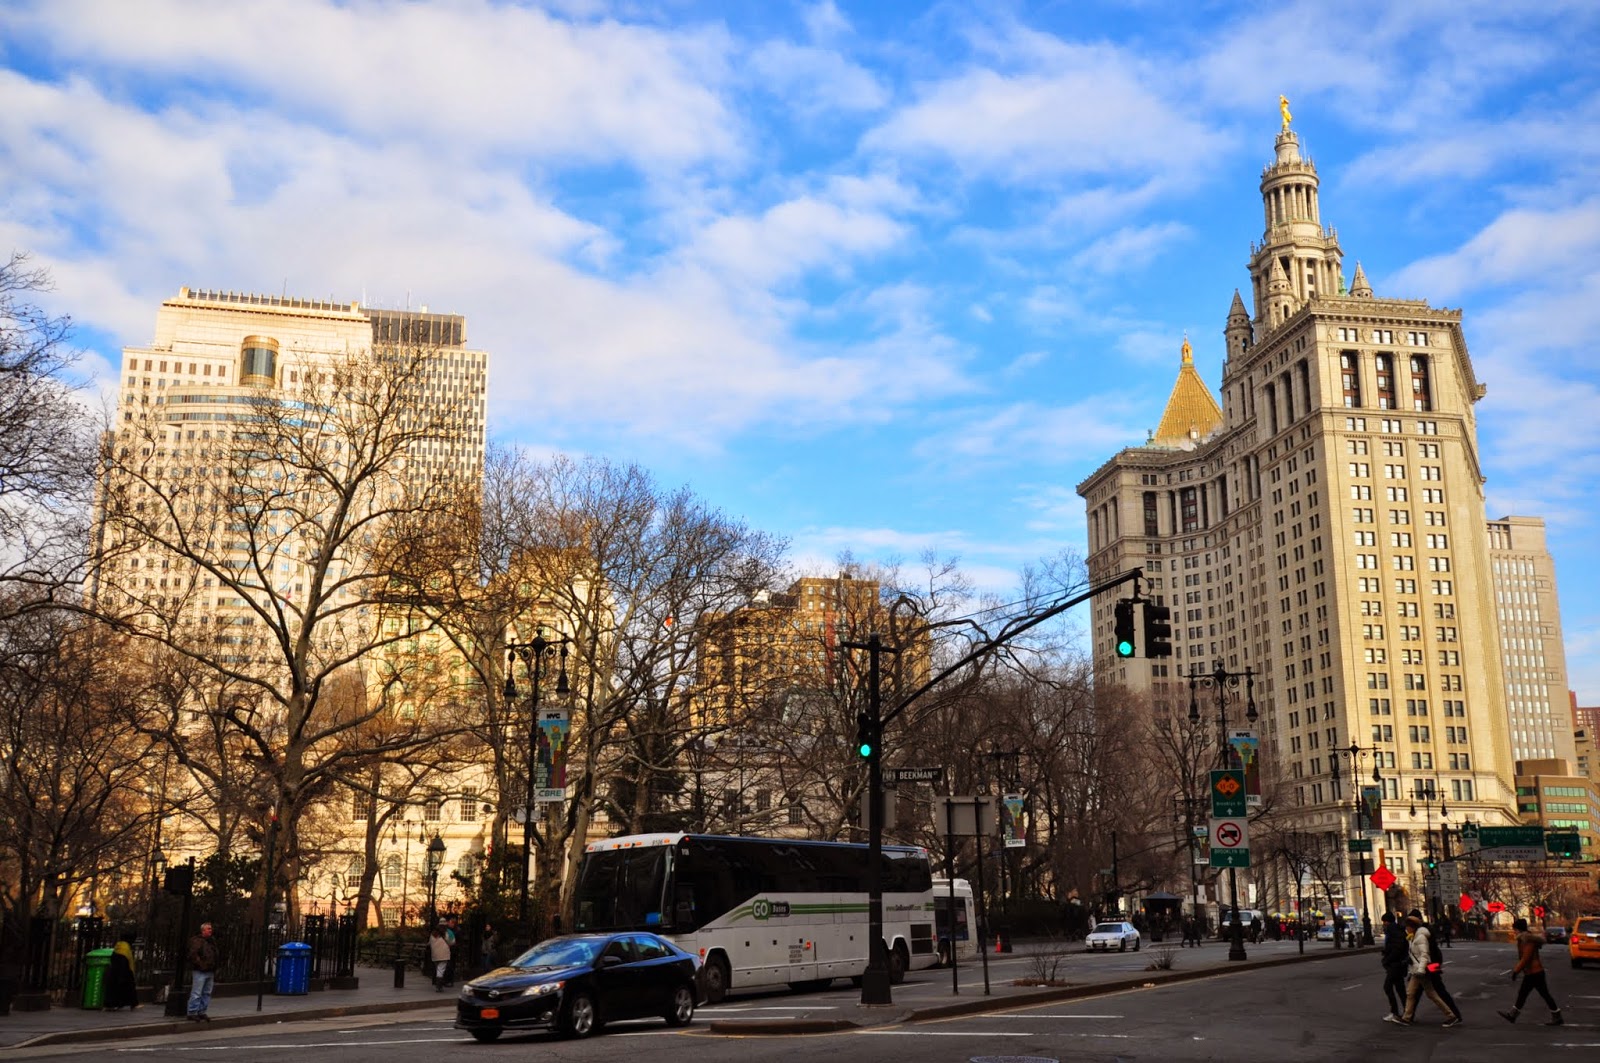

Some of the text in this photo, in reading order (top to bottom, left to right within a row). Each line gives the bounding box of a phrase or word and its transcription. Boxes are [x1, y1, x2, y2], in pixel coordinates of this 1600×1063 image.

[899, 771, 933, 779] BEEKMAN
[753, 902, 786, 917] GO Buses
